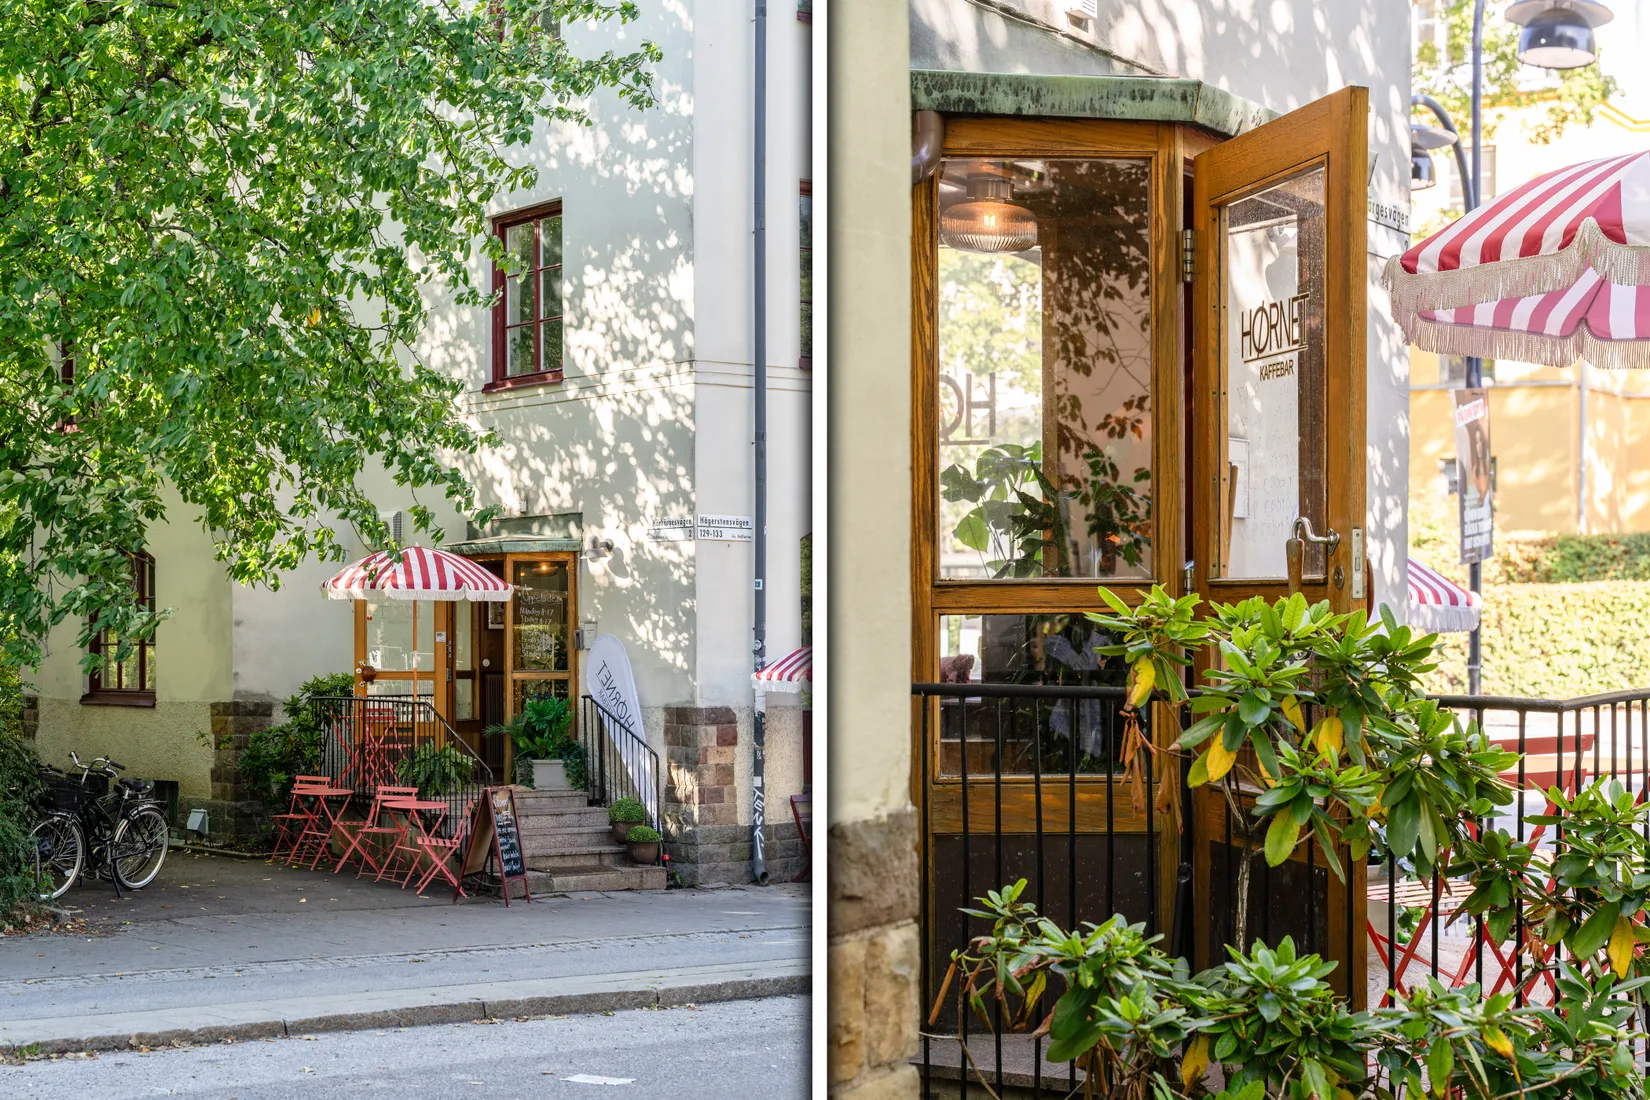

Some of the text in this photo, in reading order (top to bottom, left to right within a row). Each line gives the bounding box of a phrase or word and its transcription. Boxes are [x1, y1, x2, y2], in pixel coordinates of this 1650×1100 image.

[1241, 292, 1310, 358] HØRNET
[1260, 360, 1294, 382] KAFFEBAR
[699, 529, 724, 538] 129-133
